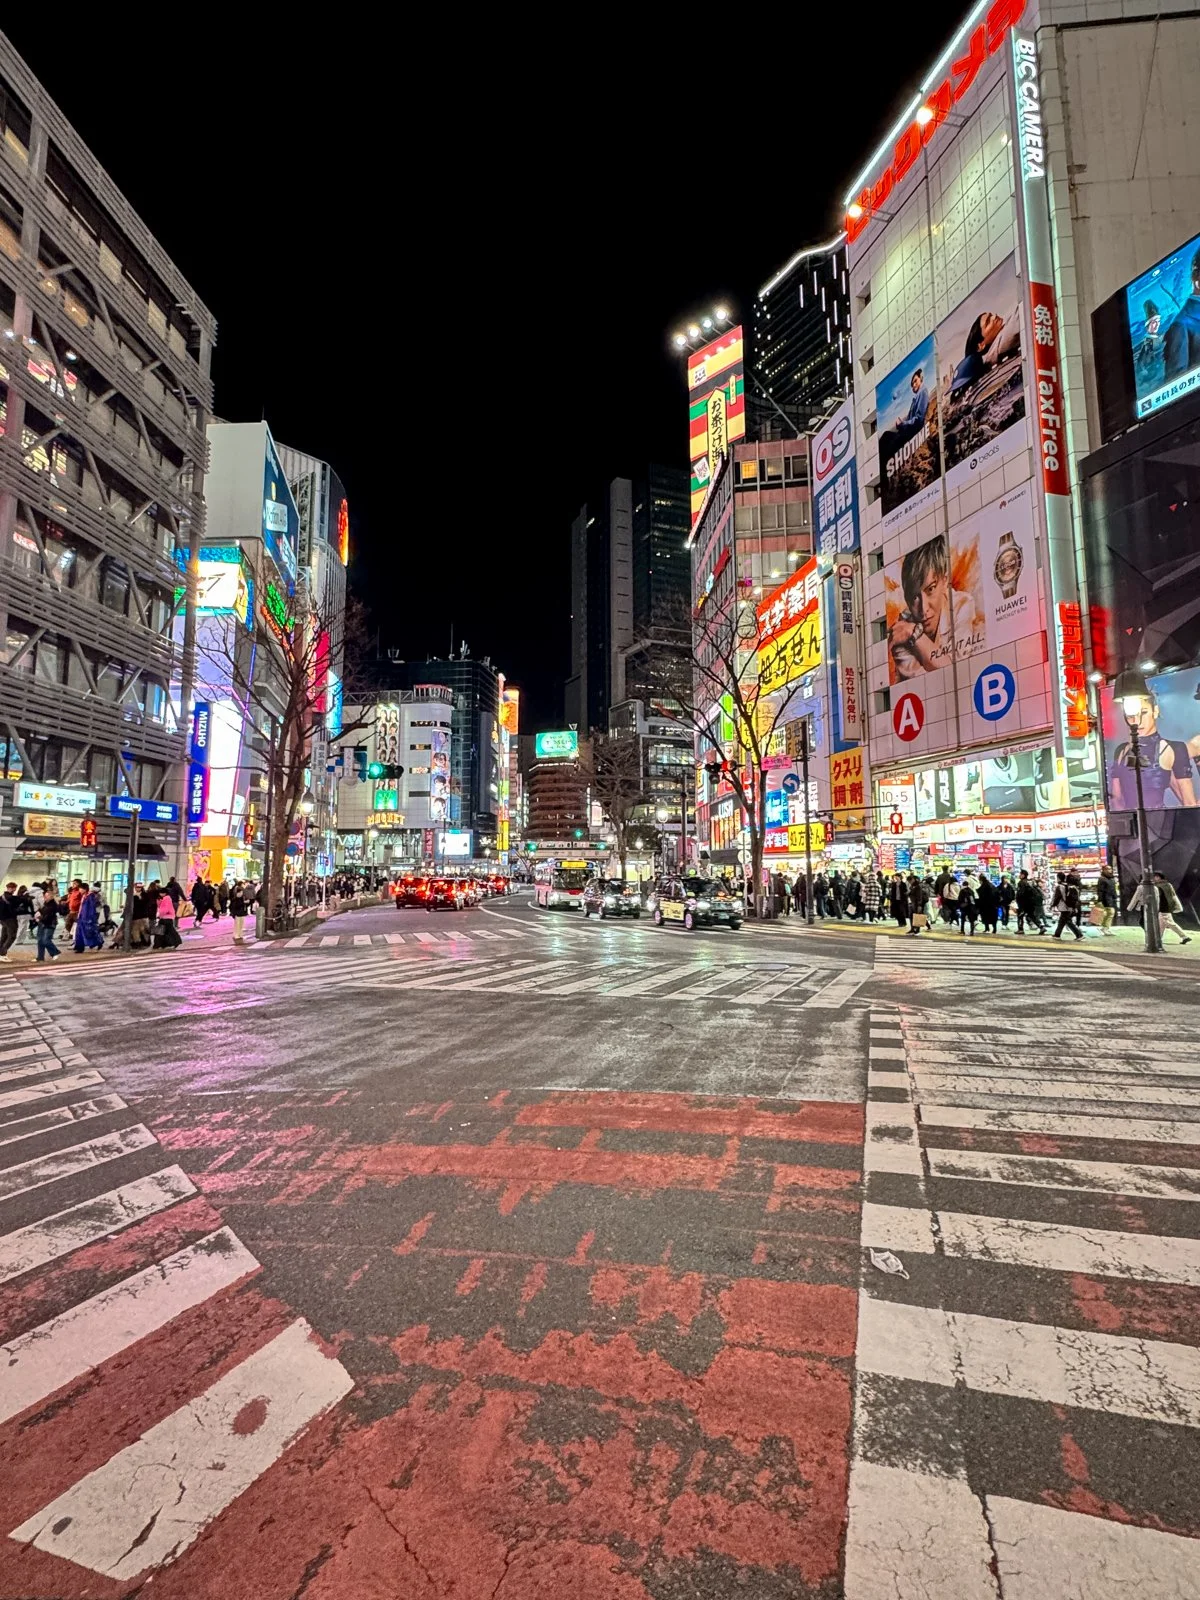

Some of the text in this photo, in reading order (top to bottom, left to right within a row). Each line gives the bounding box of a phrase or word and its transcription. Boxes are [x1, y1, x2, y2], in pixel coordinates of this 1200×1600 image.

[1015, 38, 1045, 181] BIC CAMERA
[1034, 304, 1055, 346] 免税
[711, 397, 727, 468] お茶づけ海
[1037, 367, 1060, 472] TaxFree
[815, 415, 851, 481] OS
[886, 422, 931, 478] SHOTIME
[978, 444, 1000, 464] beats
[818, 466, 853, 530] 調剤
[820, 516, 855, 557] 薬局
[759, 567, 821, 640] スギ薬局
[995, 595, 1028, 616] HUAWEI
[760, 624, 821, 685] 処方せん
[845, 668, 856, 723] 処方せん受付
[982, 671, 1007, 715] B
[197, 711, 208, 747] MIZUHO
[898, 697, 920, 736] A
[833, 754, 862, 781] クスリ
[56, 796, 76, 807] 宝くじ
[193, 774, 203, 814] みずほ銀行
[833, 781, 863, 807] 調剤
[764, 831, 788, 848] ギ薬局
[975, 824, 1032, 834] ビックカメラ
